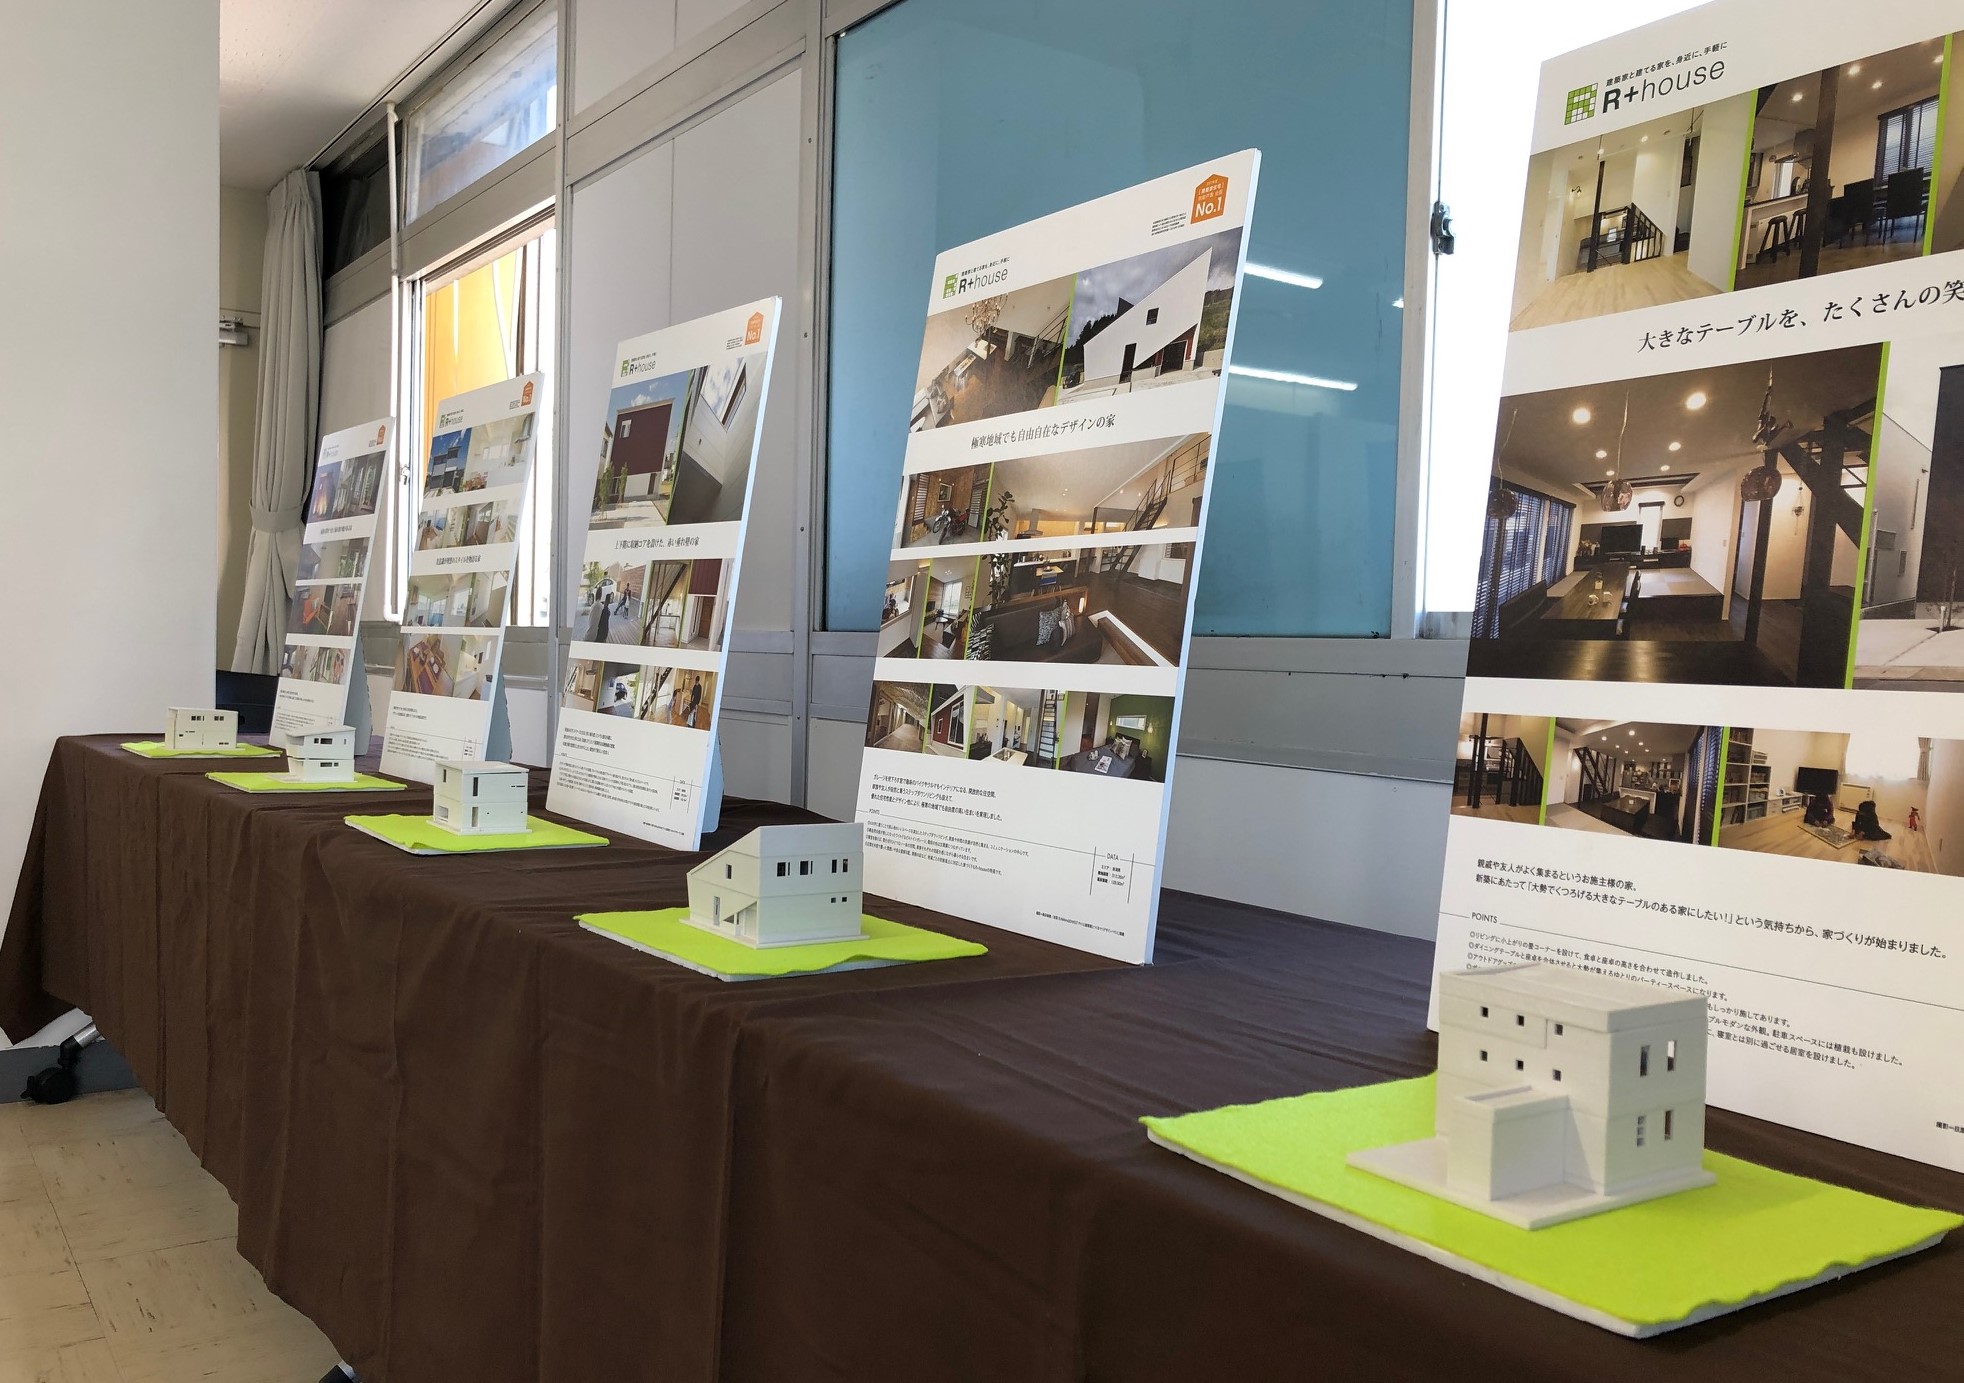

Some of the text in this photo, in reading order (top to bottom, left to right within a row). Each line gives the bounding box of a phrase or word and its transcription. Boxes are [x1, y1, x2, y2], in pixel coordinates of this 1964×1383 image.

[1606, 41, 1728, 87] 建築家と建てる家を、身近に、手軽に
[1602, 60, 1725, 114] R+house
[1195, 197, 1222, 218] No.1
[958, 268, 1008, 294] R+house
[971, 413, 1116, 450] 極寒地域でも自由自在なデザインの家
[1477, 858, 1637, 892] 親戚や友人がよく集まるというお施主様の家。
[1471, 912, 1498, 924] POINTS
